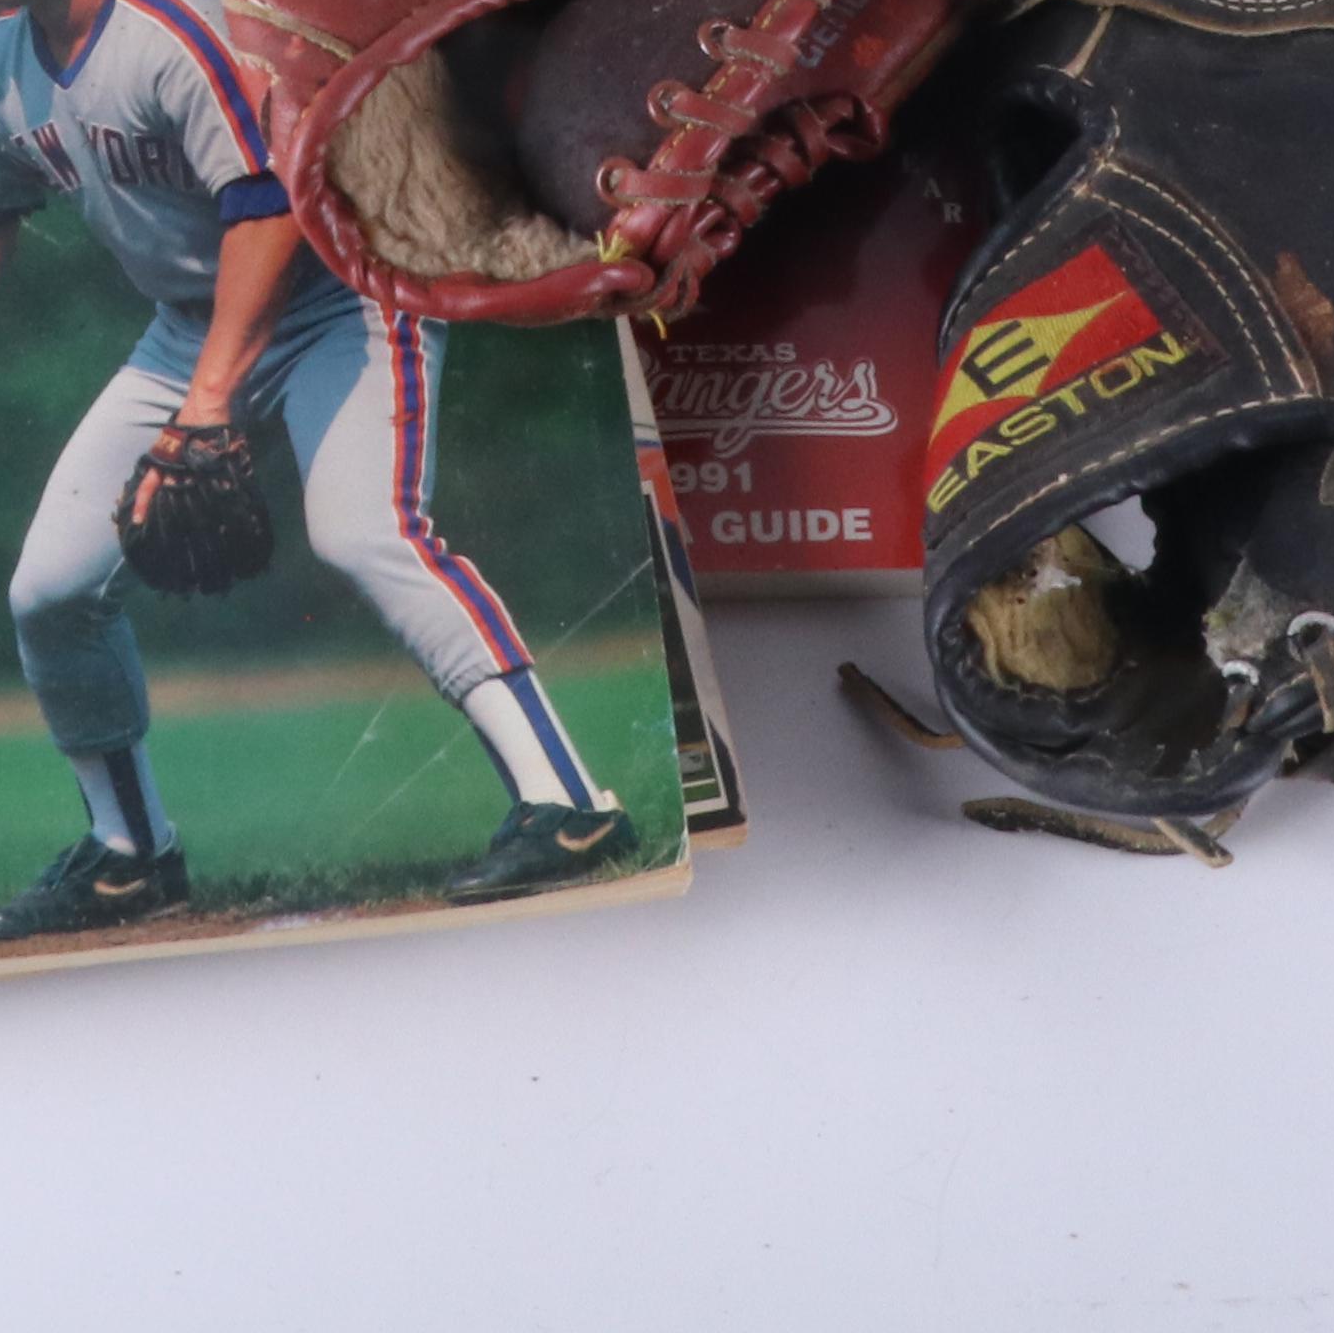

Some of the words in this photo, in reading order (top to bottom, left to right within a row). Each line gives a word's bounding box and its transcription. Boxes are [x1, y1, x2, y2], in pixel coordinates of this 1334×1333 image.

[667, 343, 797, 363] TEXAS
[926, 331, 1192, 514] EASTON
[670, 461, 753, 493] 991
[711, 508, 873, 545] GUIDE
